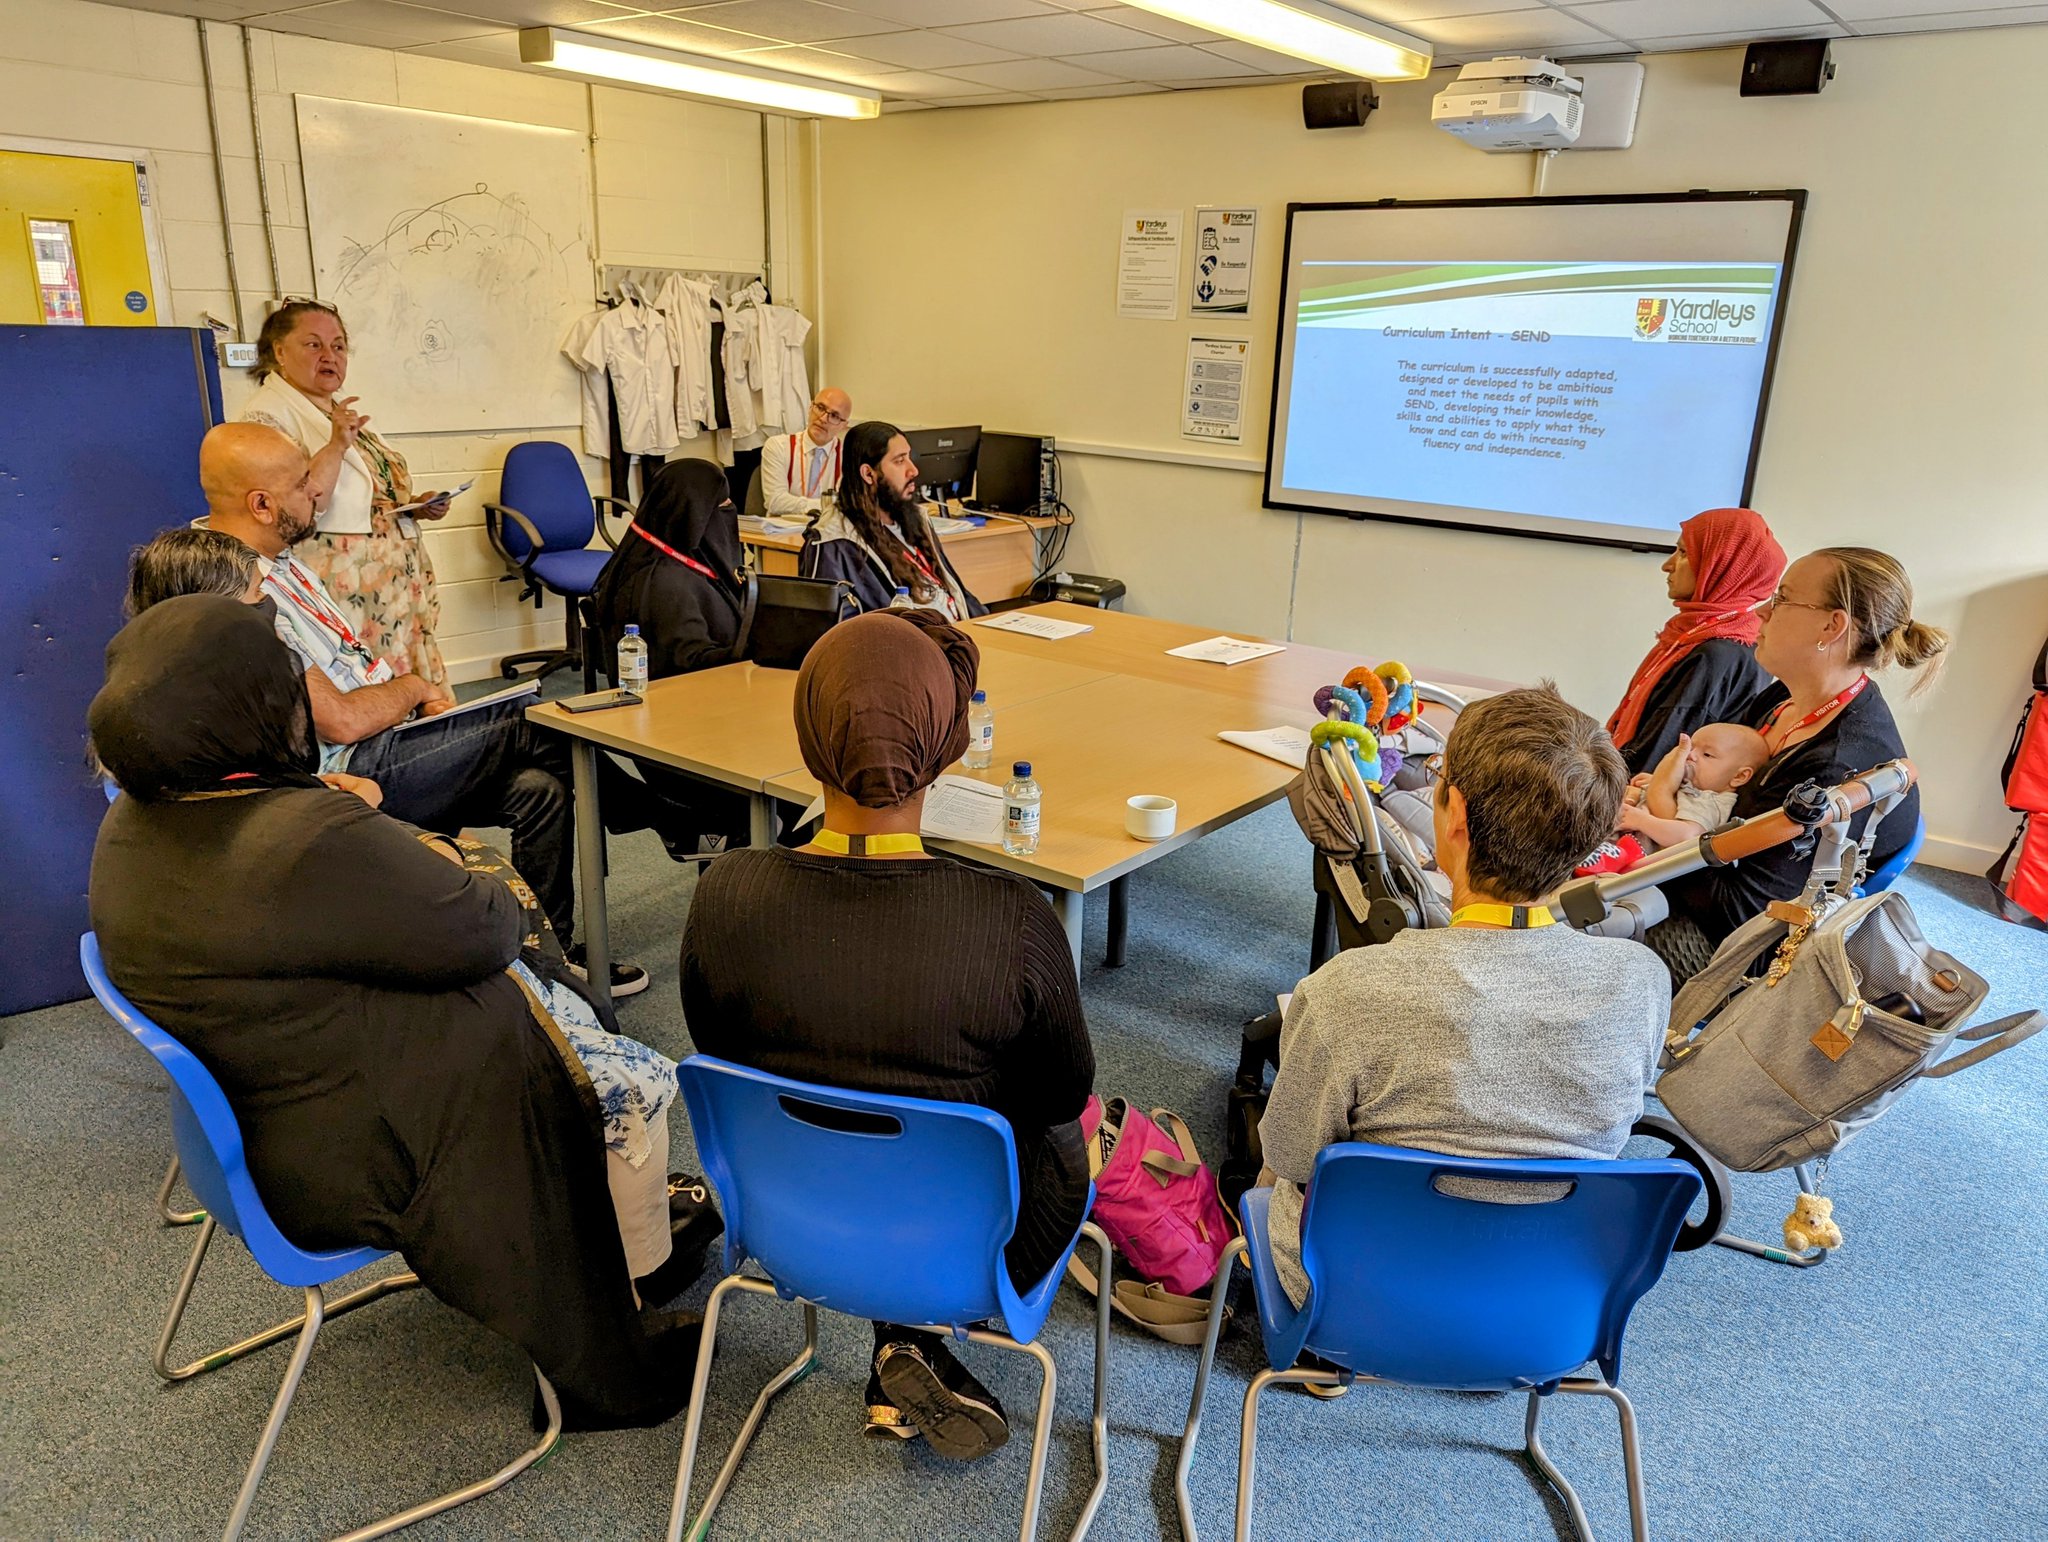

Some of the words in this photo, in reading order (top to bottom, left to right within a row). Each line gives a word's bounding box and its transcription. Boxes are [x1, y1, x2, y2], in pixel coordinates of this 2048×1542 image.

[1669, 298, 1756, 328] Yardleys
[1382, 325, 1445, 339] Curriculum
[1450, 328, 1492, 340] Intent
[1510, 330, 1551, 343] SEND
[1669, 319, 1717, 334] School
[1398, 360, 1417, 370] The
[1421, 362, 1475, 373] curriculum
[1480, 364, 1488, 374] is
[1493, 366, 1561, 380] successfully
[1565, 368, 1618, 382] adapted,
[1399, 373, 1443, 386] designed
[1448, 377, 1459, 385] or
[1463, 377, 1517, 390] developed
[1522, 380, 1533, 389] to
[1538, 380, 1552, 391] be
[1557, 382, 1613, 394] ambitious
[1408, 387, 1426, 396] and
[1430, 389, 1456, 398] meet
[1461, 390, 1479, 400] the
[1483, 392, 1514, 402] needs
[1519, 393, 1532, 403] of
[1536, 395, 1568, 407] pupils
[1573, 396, 1599, 407] with
[1404, 399, 1438, 411] SEND,
[1444, 402, 1498, 416] developing
[1503, 406, 1531, 416] their
[1535, 407, 1597, 423] knowledge,
[1396, 411, 1421, 421] skills
[1426, 414, 1444, 423] and
[1448, 415, 1490, 426] abilities
[1496, 419, 1507, 428] to
[1511, 420, 1540, 432] apply
[1545, 422, 1573, 433] what
[1578, 424, 1606, 438] they
[1409, 424, 1434, 435] know
[1438, 427, 1457, 437] and
[1460, 430, 1479, 438] can
[1483, 430, 1496, 440] do
[1501, 431, 1524, 442] with
[1529, 433, 1586, 450] increasing
[1423, 438, 1460, 452] fluency
[1464, 442, 1484, 452] and
[1488, 443, 1565, 459] independence.
[1814, 699, 1840, 717] VISITOR
